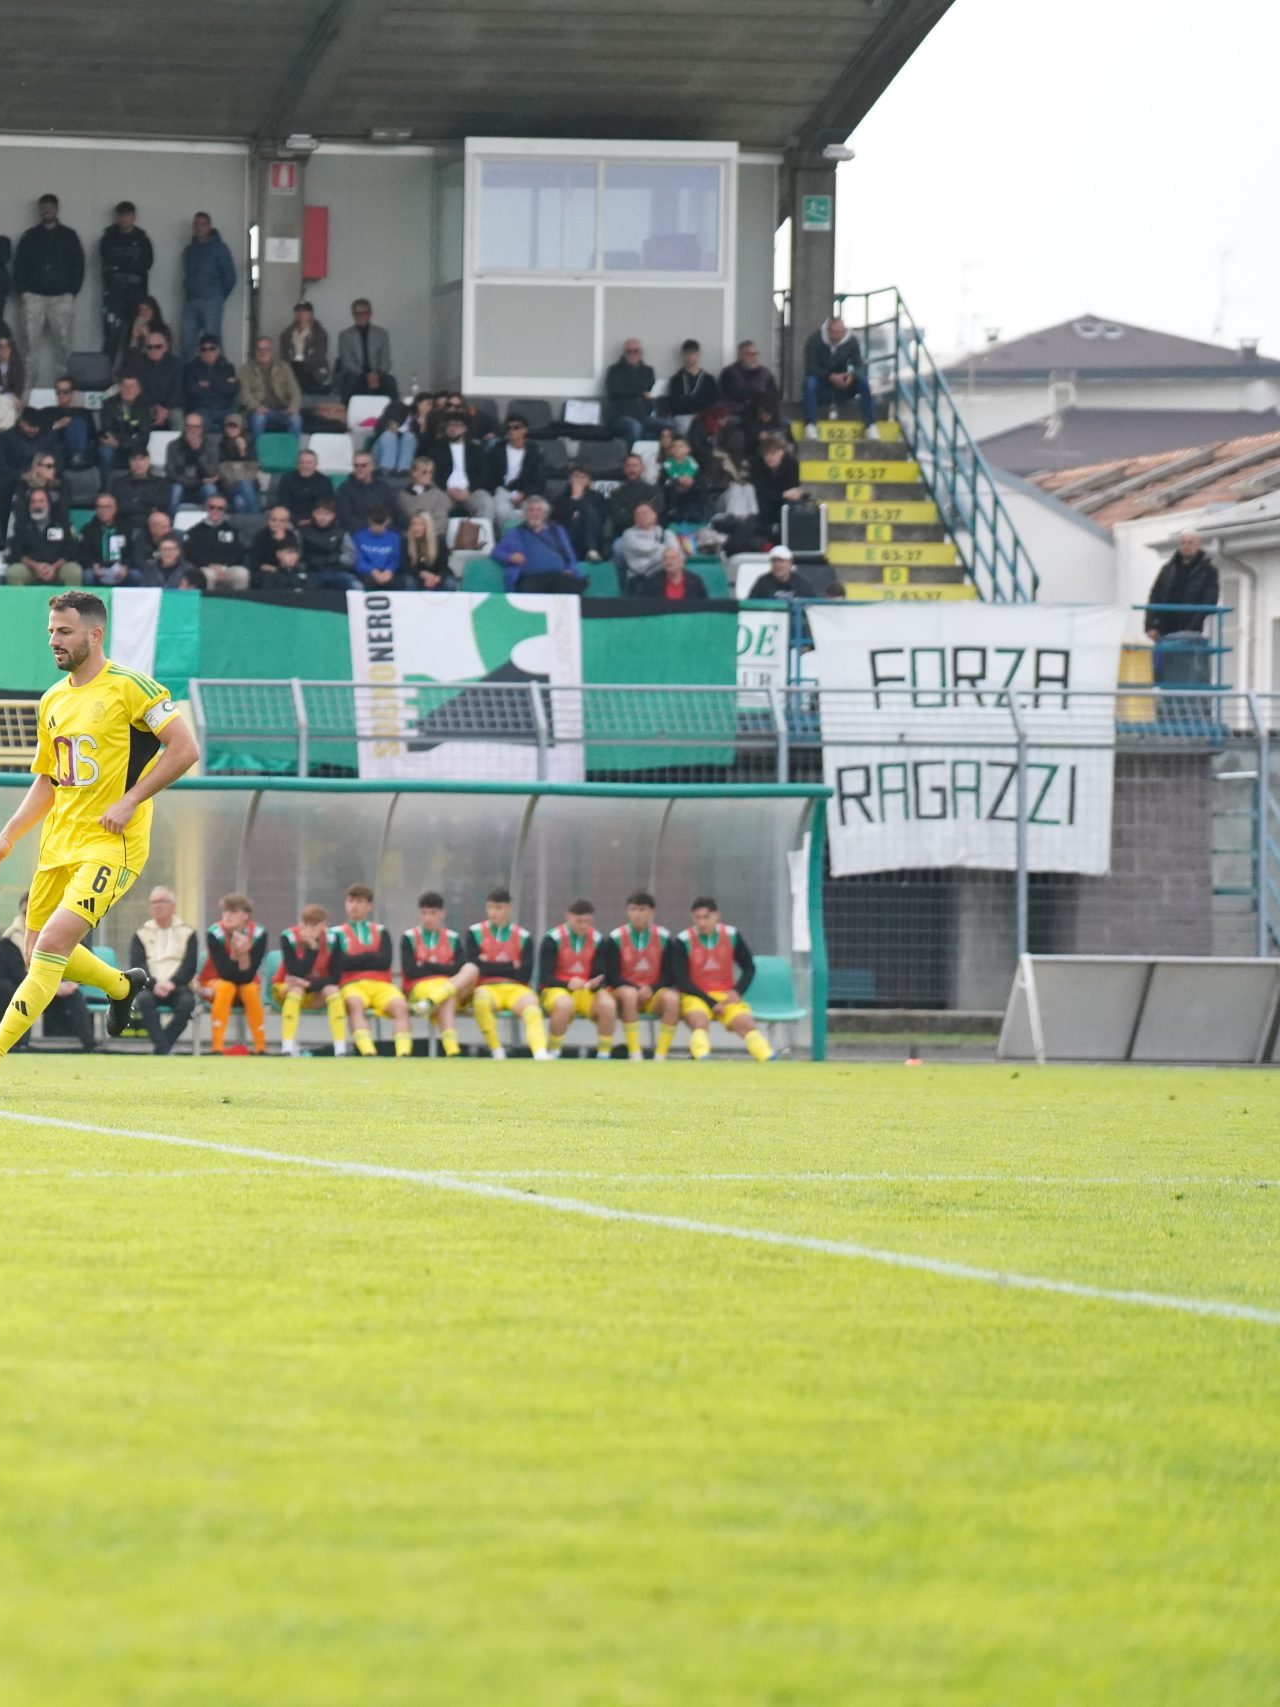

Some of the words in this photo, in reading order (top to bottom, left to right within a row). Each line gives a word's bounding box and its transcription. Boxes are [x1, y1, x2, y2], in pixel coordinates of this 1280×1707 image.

[845, 467, 886, 480] 63-37
[860, 509, 902, 520] 63-37
[881, 550, 922, 562] 63-37
[871, 646, 1070, 709] FORZA
[837, 760, 1076, 825] RAGAZZI
[92, 865, 112, 894] 6
